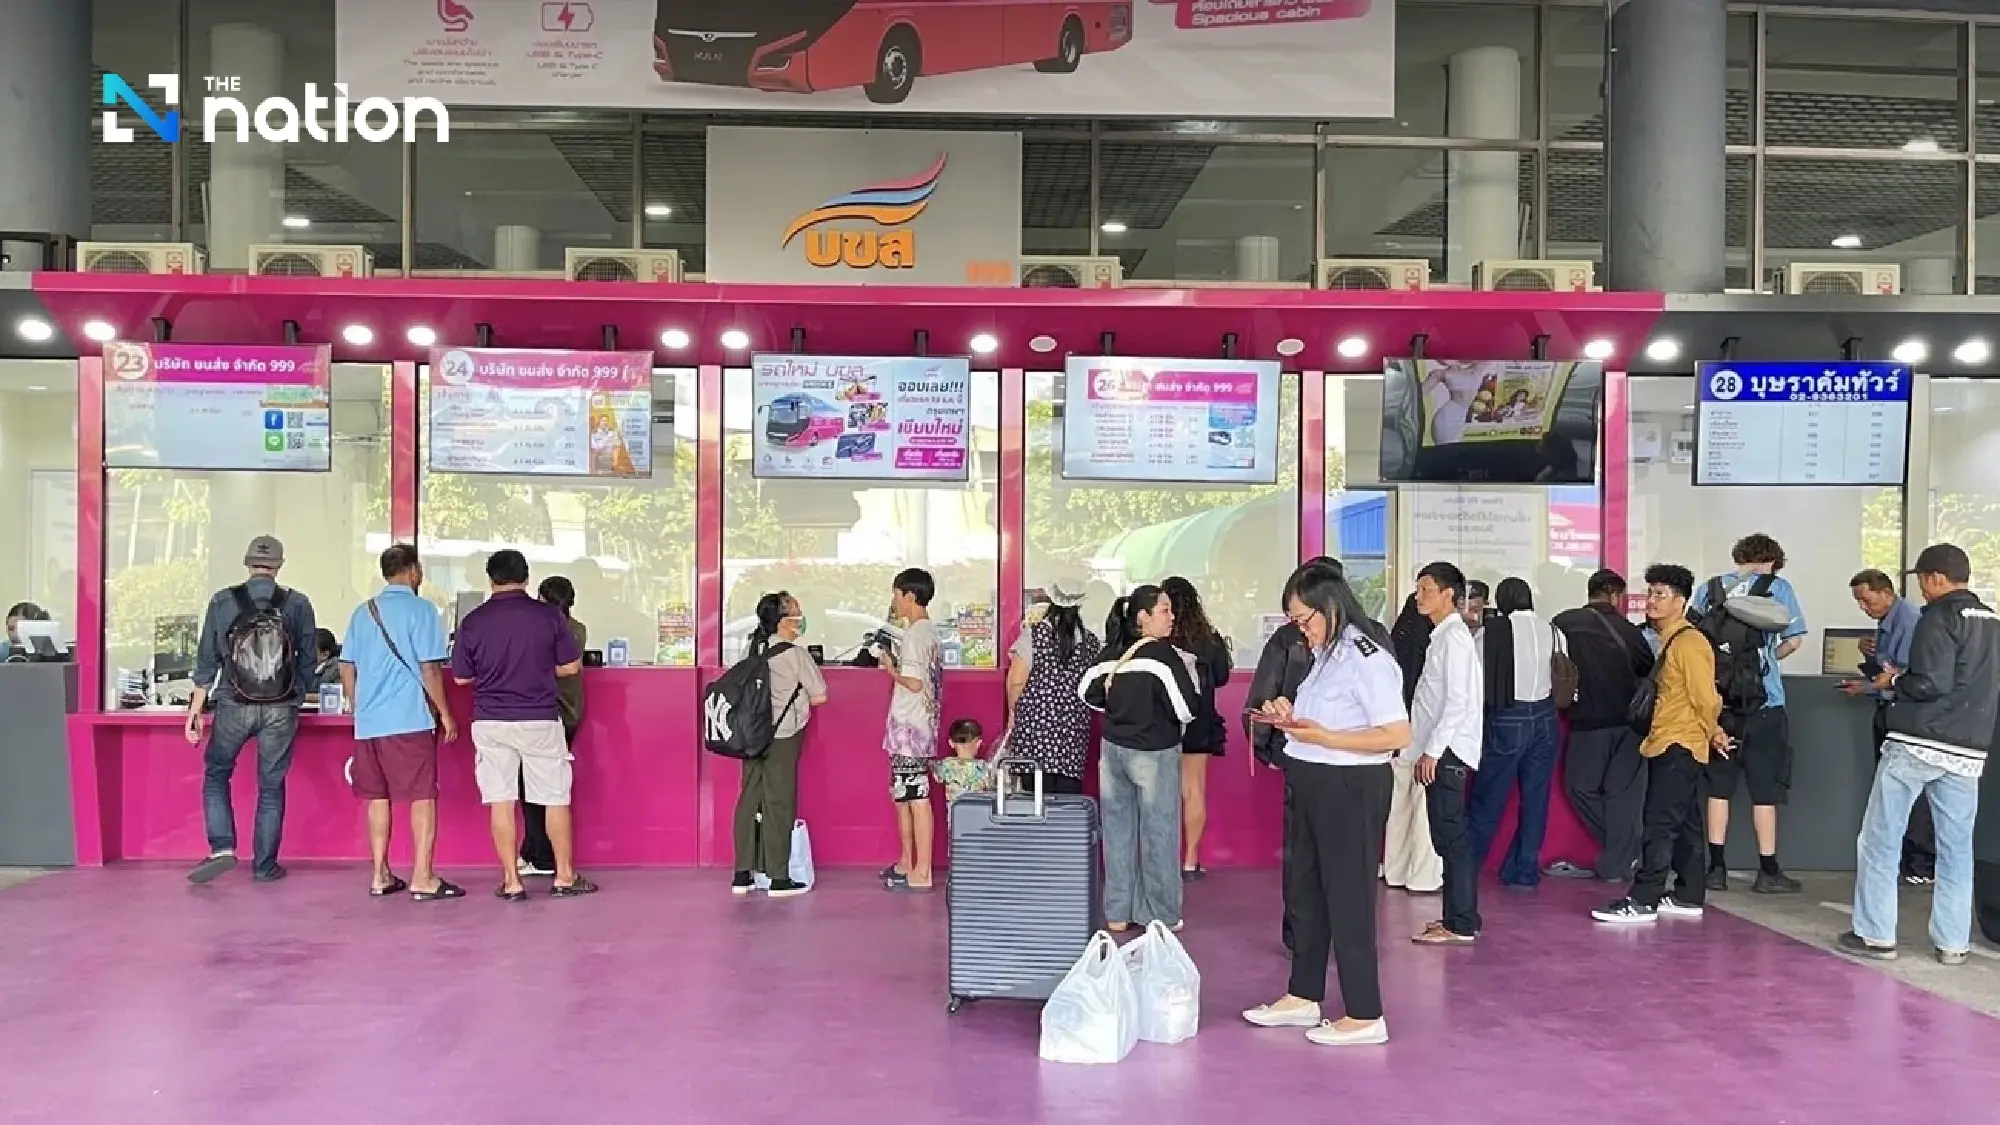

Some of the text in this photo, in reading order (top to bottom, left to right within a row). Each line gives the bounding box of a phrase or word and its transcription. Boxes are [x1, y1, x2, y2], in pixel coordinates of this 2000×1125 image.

[1276, 6, 1321, 18] cabin
[806, 230, 914, 269] บขส
[116, 353, 143, 372] 23
[153, 356, 296, 372] บริษัท ขนส่ง จำกัด 999
[444, 360, 468, 377] 24
[479, 362, 515, 377] บริษัท
[593, 365, 618, 379] 999
[761, 359, 818, 377] รถใหม่
[1213, 382, 1233, 393] 999
[1716, 376, 1737, 393] 28
[897, 417, 964, 435] เชียงใหม่
